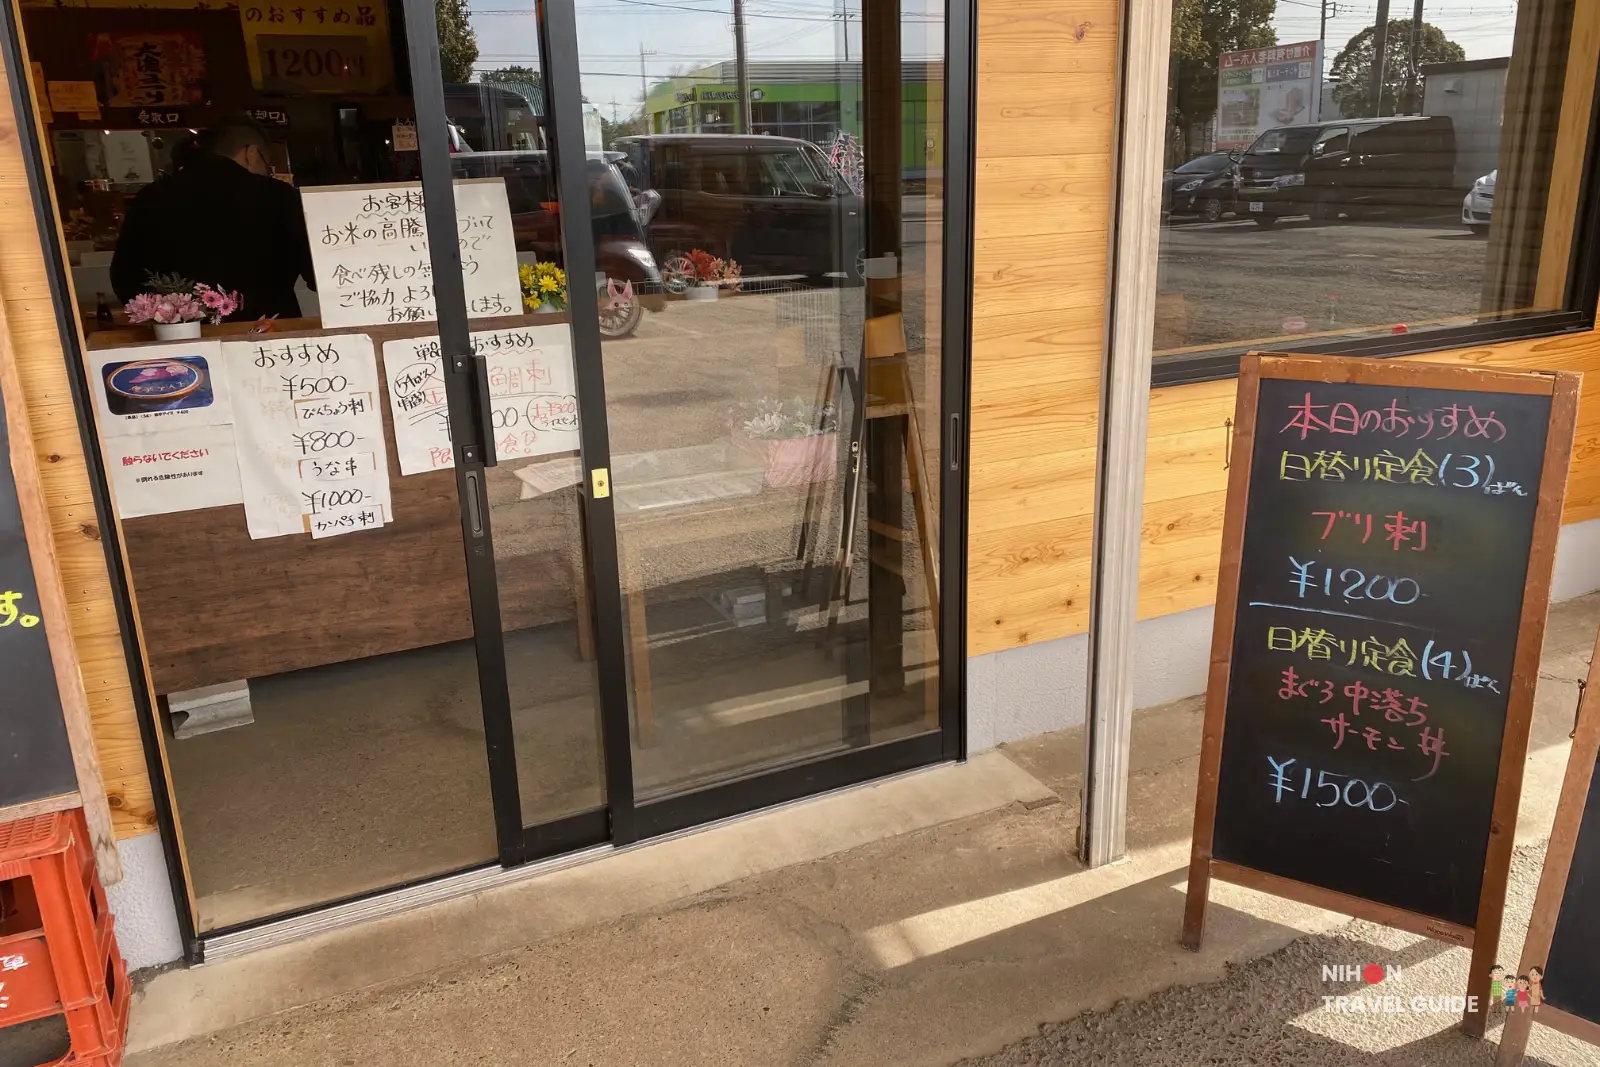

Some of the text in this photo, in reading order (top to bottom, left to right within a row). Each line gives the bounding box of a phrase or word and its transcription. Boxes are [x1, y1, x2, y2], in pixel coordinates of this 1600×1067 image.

[254, 342, 340, 369] おすすめ
[292, 430, 365, 455] ¥800-
[122, 448, 209, 467] 触らないでください
